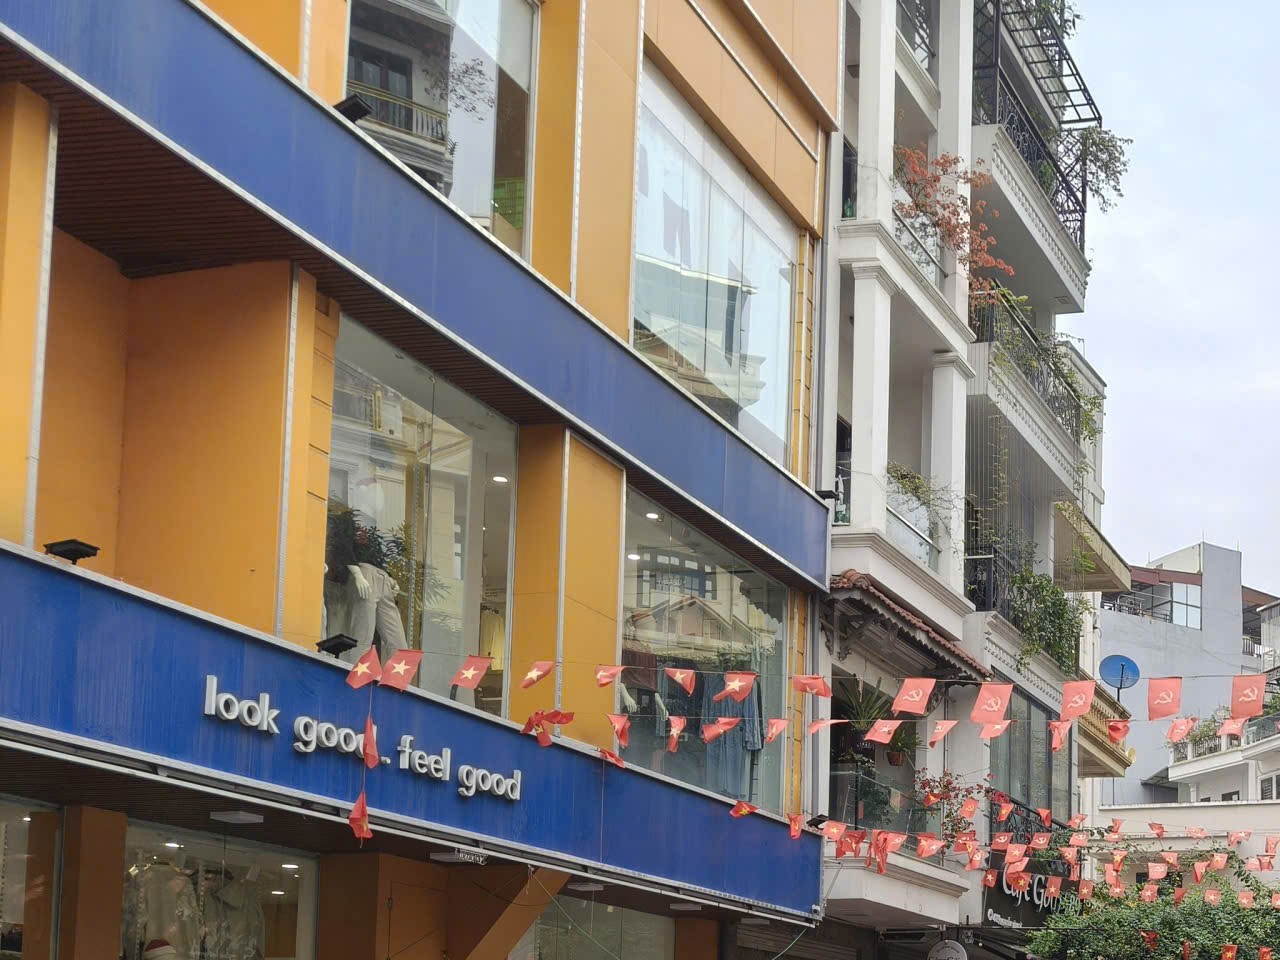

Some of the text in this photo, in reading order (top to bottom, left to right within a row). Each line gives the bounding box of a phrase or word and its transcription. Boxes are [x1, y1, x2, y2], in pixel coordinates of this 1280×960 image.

[203, 675, 280, 734] look
[397, 734, 451, 781] feel
[457, 765, 522, 801] good
